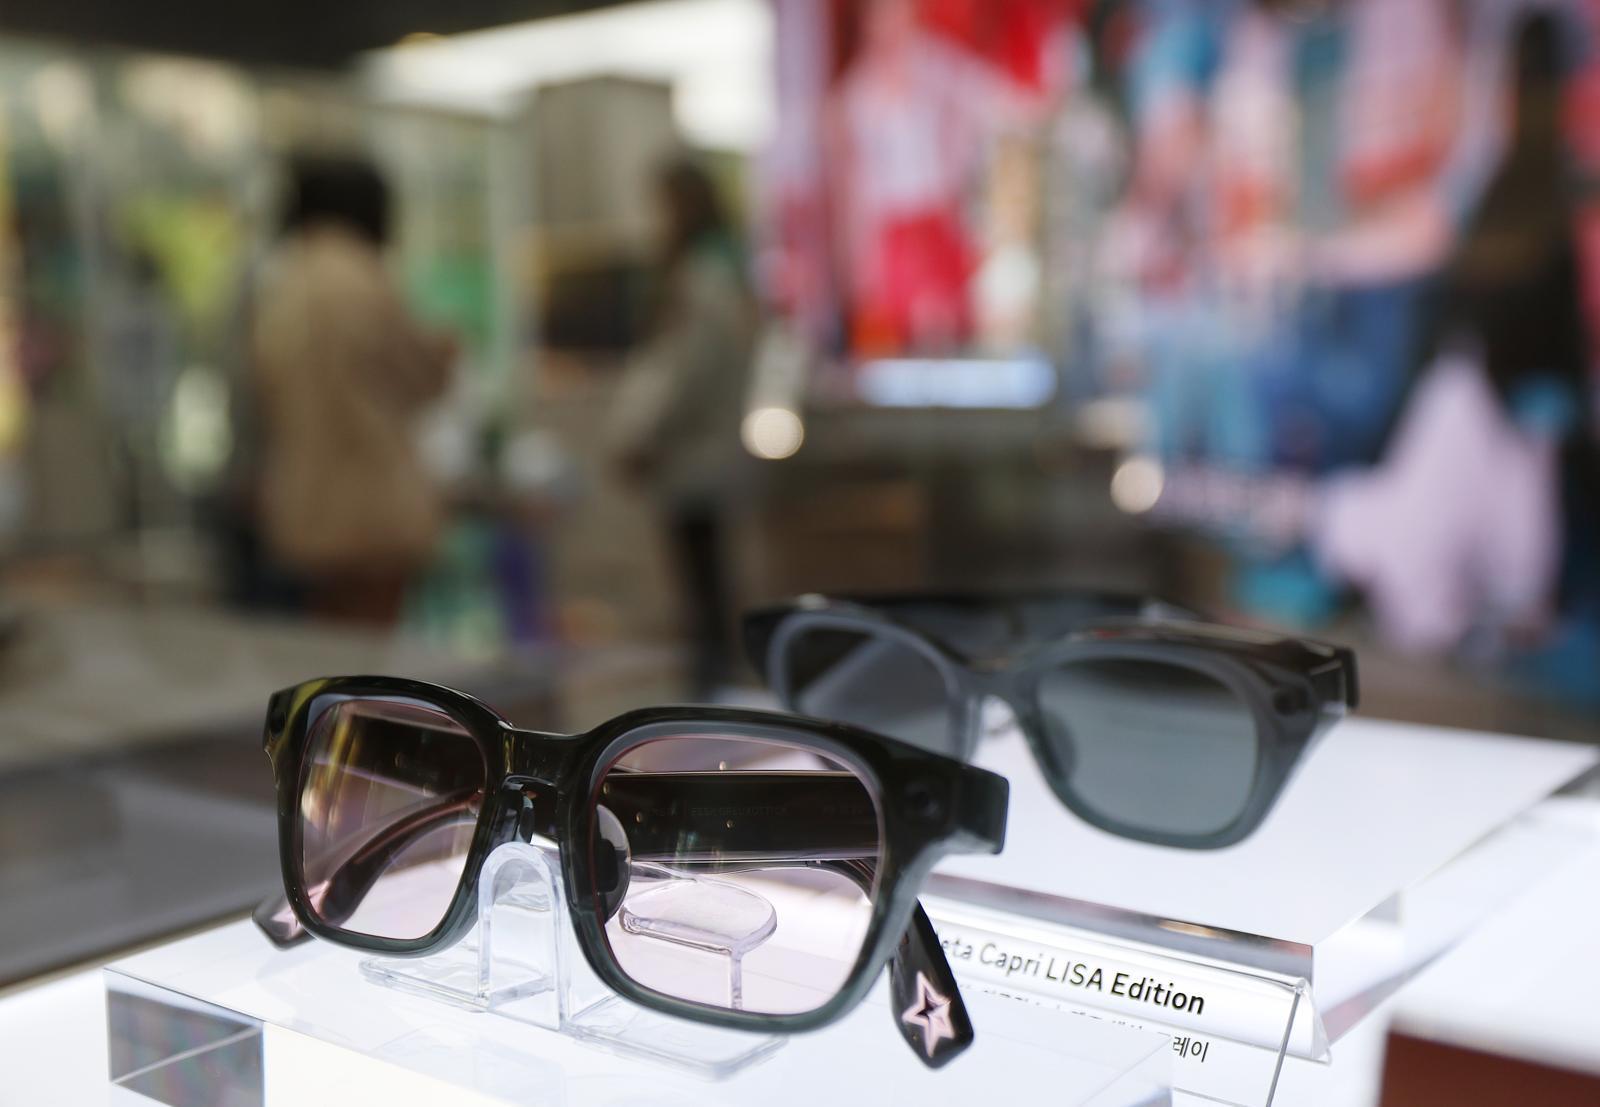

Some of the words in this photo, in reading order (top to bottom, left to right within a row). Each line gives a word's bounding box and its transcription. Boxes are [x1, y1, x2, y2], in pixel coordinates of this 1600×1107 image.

[937, 931, 973, 960] eta
[979, 942, 1044, 977] Capri
[1045, 957, 1103, 992] LISA
[1110, 972, 1205, 1015] Edition
[1158, 1031, 1210, 1063] 레이
